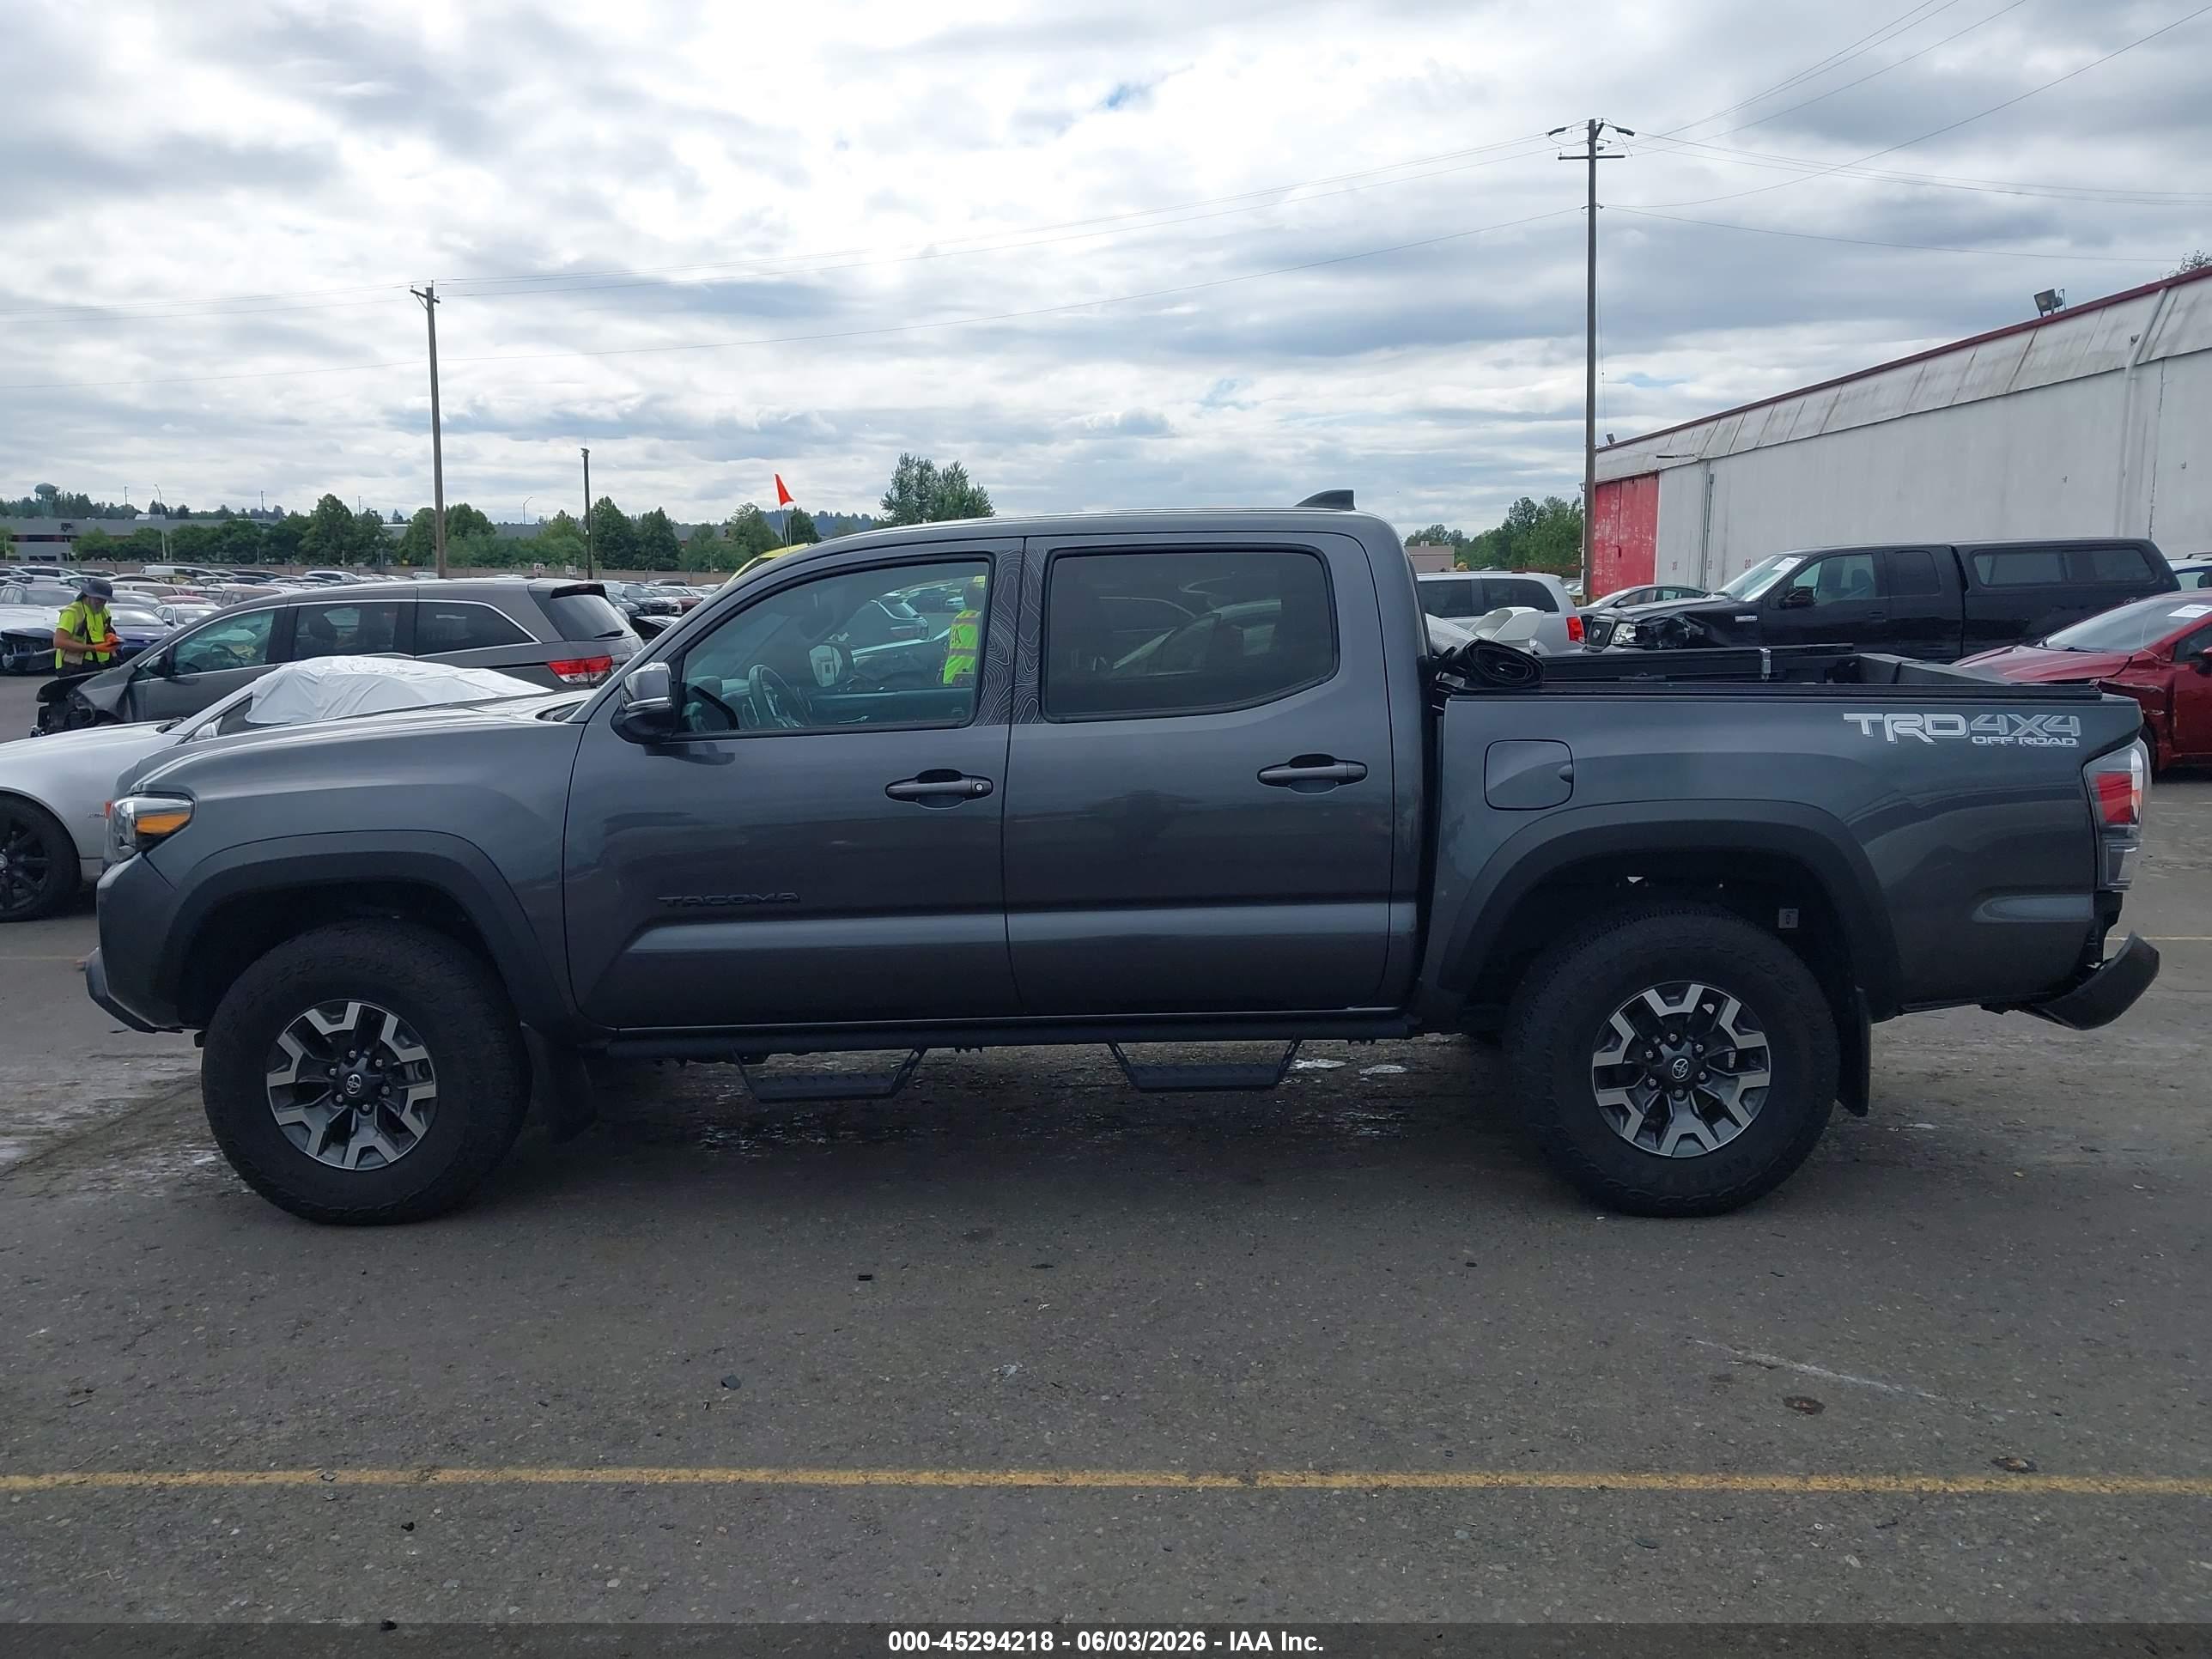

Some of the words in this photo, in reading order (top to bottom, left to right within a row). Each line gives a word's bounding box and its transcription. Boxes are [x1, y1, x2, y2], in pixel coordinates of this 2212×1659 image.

[1844, 713, 1970, 745] TRD
[1972, 736, 2014, 746] OFF
[2018, 737, 2080, 747] ROAD
[657, 892, 801, 908] TACOMA
